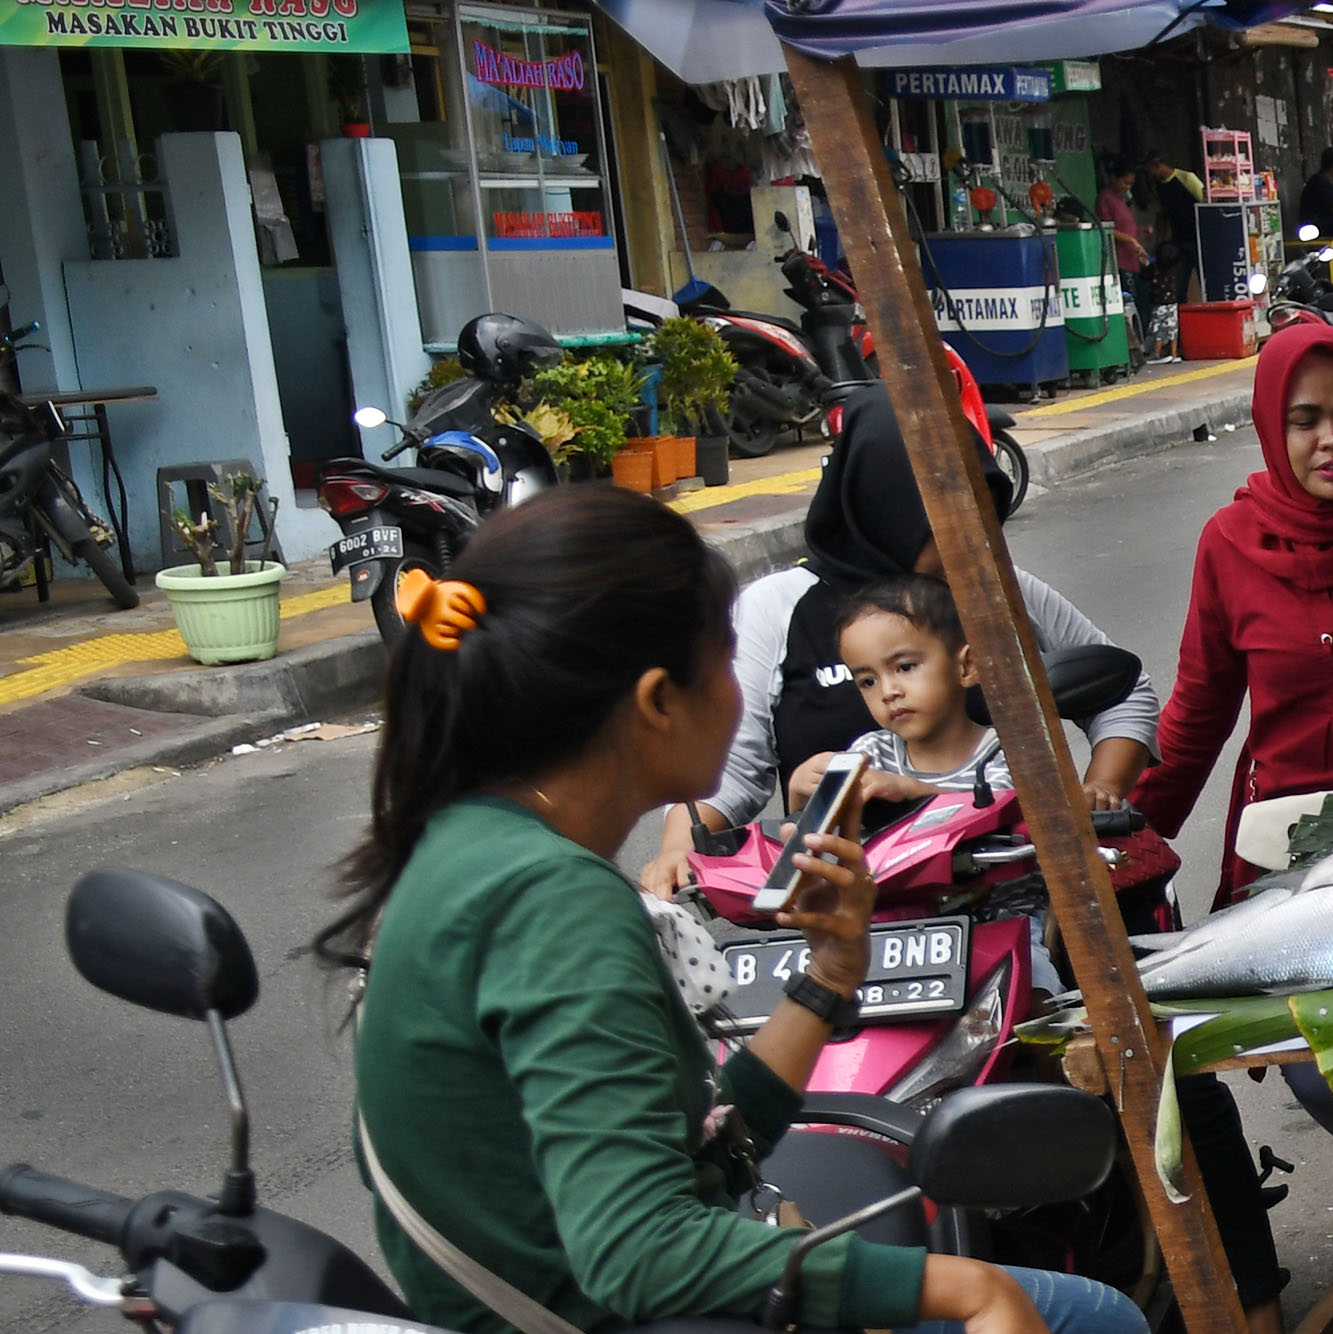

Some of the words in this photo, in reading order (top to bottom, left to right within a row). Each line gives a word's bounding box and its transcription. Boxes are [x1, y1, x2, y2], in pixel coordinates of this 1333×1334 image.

[46, 12, 178, 37] MASAKAN
[182, 17, 258, 39] BUKIT
[263, 21, 347, 42] TINGGI
[548, 51, 584, 90] RASO
[896, 72, 1005, 95] PERTAMAX
[339, 534, 367, 553] 6002
[372, 529, 398, 543] BVF
[737, 954, 757, 985] B
[882, 932, 952, 969] BNB
[838, 1127, 899, 1145] YAMAHA
